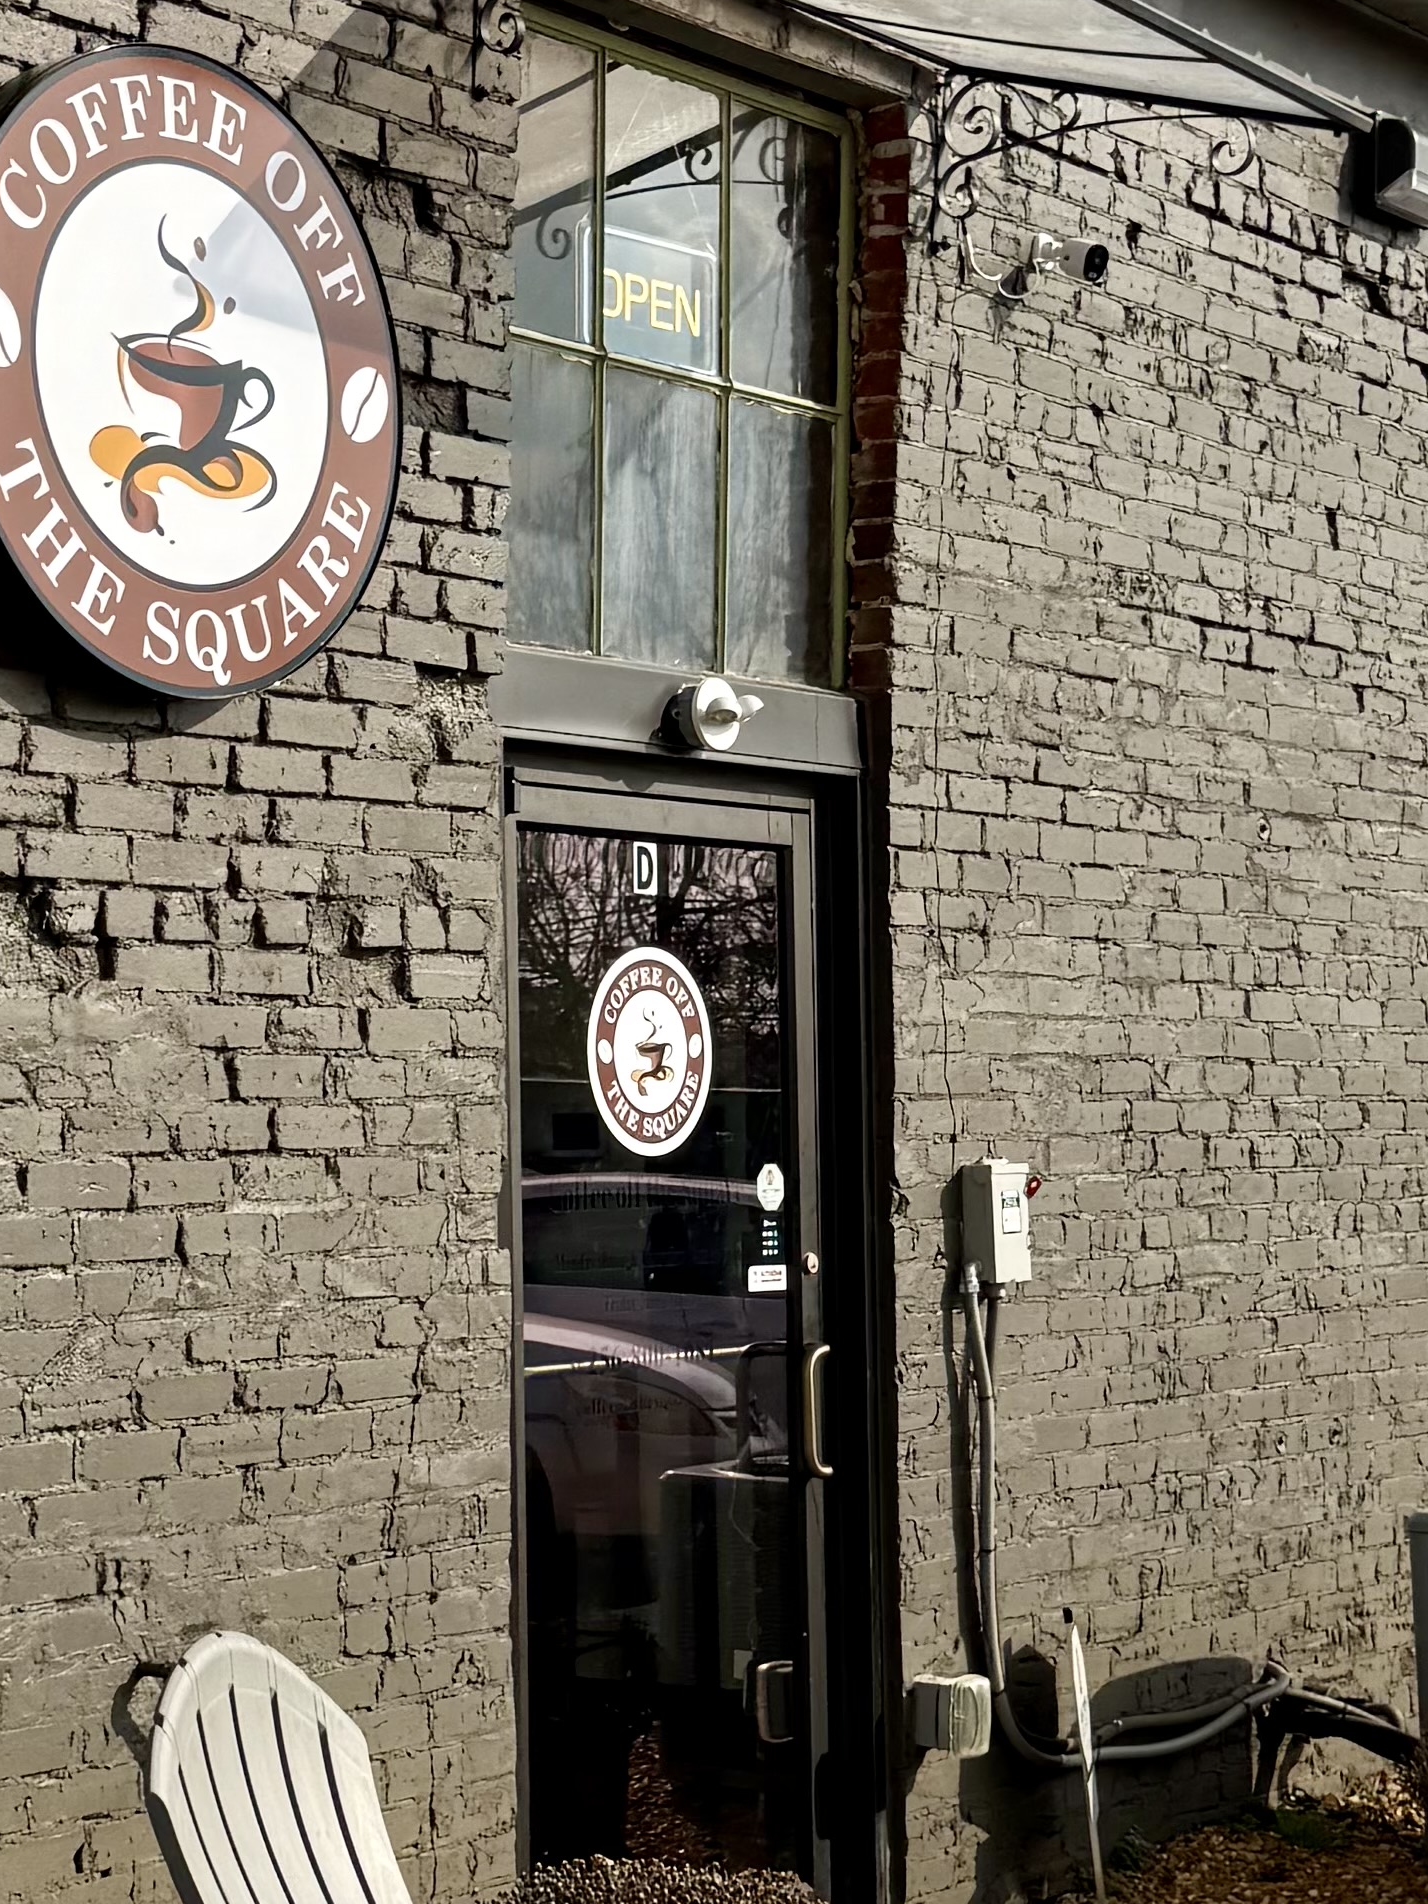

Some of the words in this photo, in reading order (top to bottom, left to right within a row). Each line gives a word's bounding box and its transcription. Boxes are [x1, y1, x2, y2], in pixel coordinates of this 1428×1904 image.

[0, 73, 247, 231] COFFEE
[263, 149, 366, 312] OFF
[603, 268, 701, 338] OPEN
[141, 479, 372, 687] SQUARE
[637, 845, 654, 891] D
[604, 966, 663, 1024] COFFEE
[665, 976, 696, 1020] OFF
[607, 1080, 640, 1133] THE
[642, 1070, 700, 1141] SQUARE
